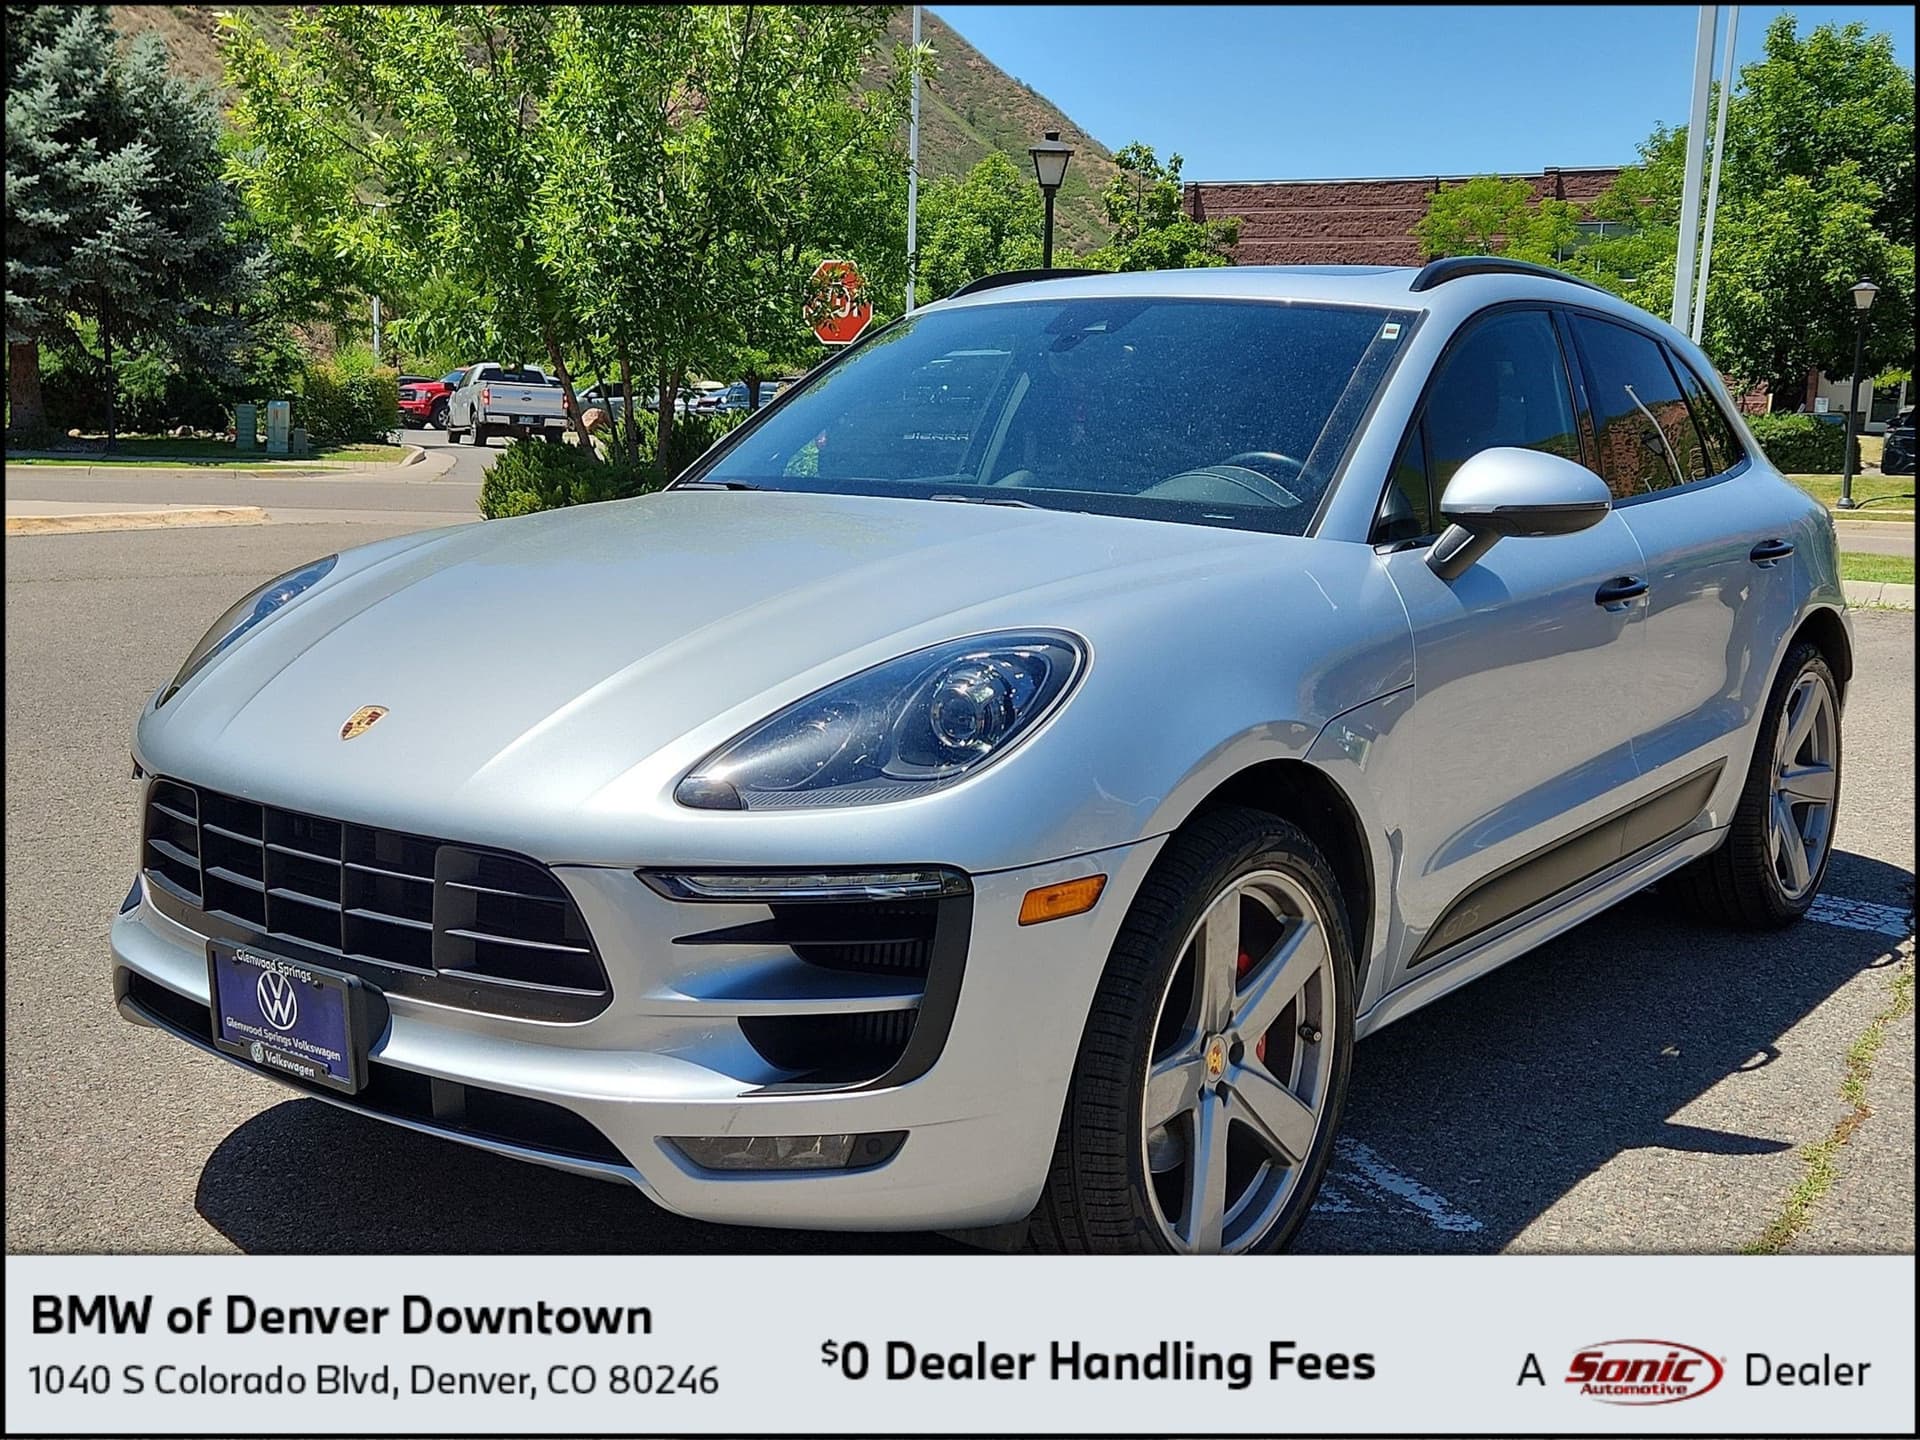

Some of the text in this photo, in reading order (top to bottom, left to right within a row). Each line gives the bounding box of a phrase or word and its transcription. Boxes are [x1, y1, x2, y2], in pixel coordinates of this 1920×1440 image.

[1443, 904, 1480, 938] GTS
[236, 948, 312, 983] Glenwood Springs
[226, 1016, 263, 1037] Glenwood
[263, 1028, 292, 1047] Springs
[292, 1037, 341, 1062] Volkswagen
[264, 1050, 315, 1077] Volkswagen
